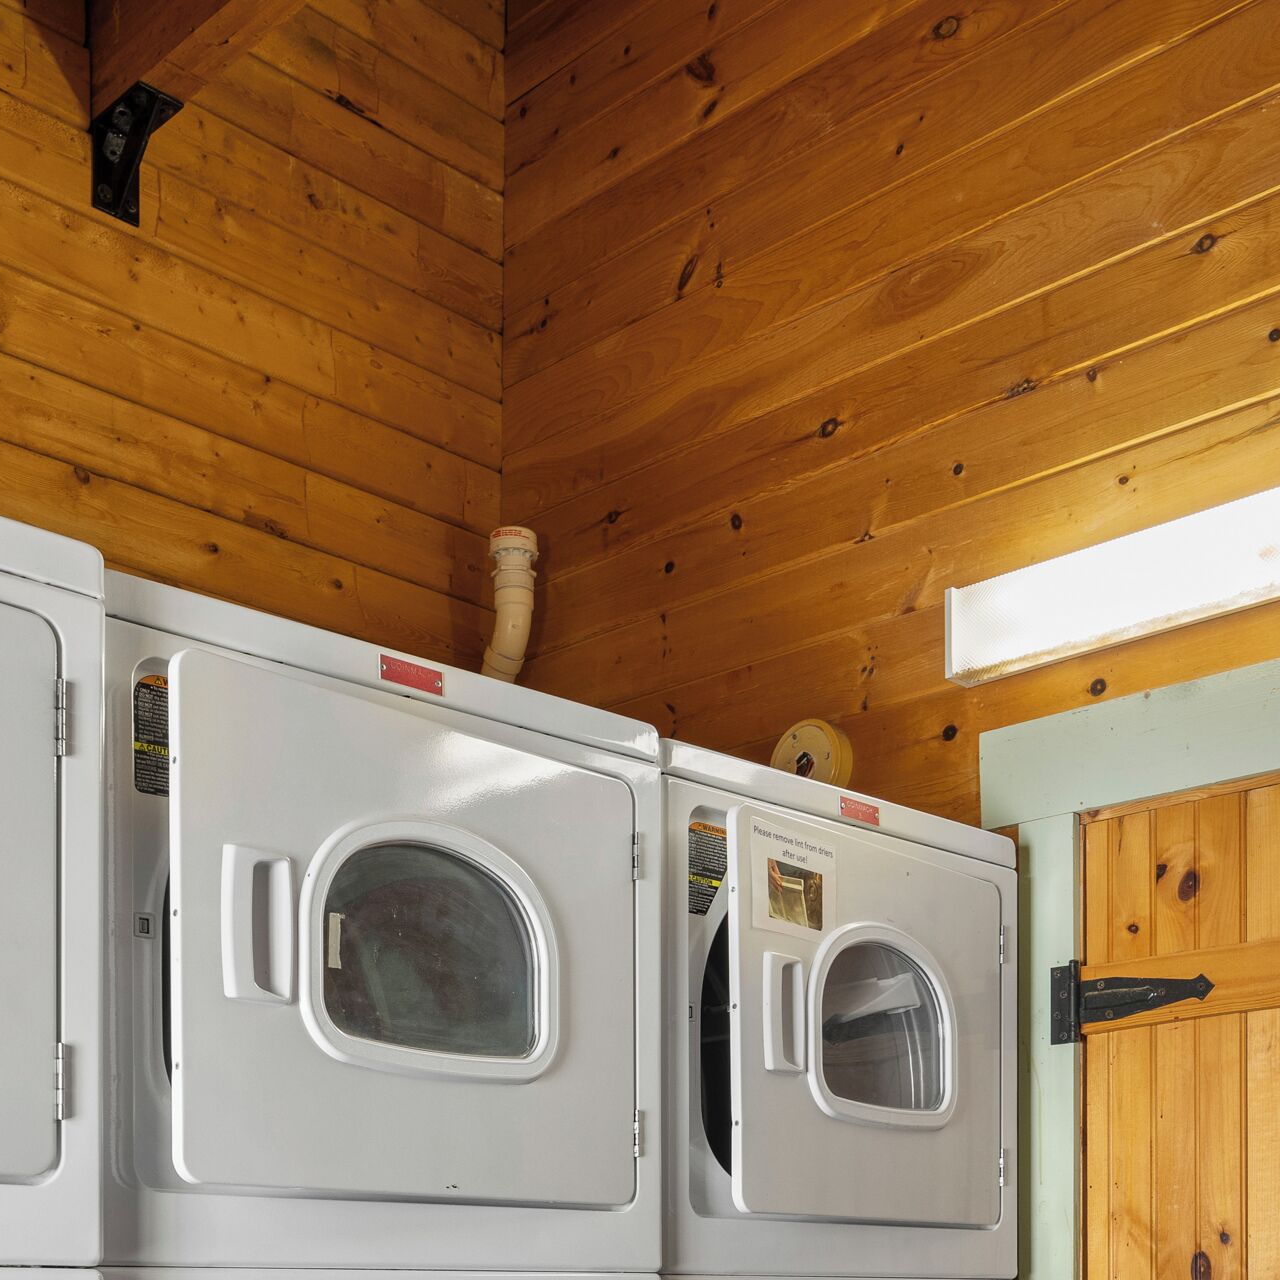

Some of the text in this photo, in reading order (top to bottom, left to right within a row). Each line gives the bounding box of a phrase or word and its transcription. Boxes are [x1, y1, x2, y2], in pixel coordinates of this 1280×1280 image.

[754, 825, 833, 859] Please remove lint from driers
[782, 850, 808, 864] after use!
